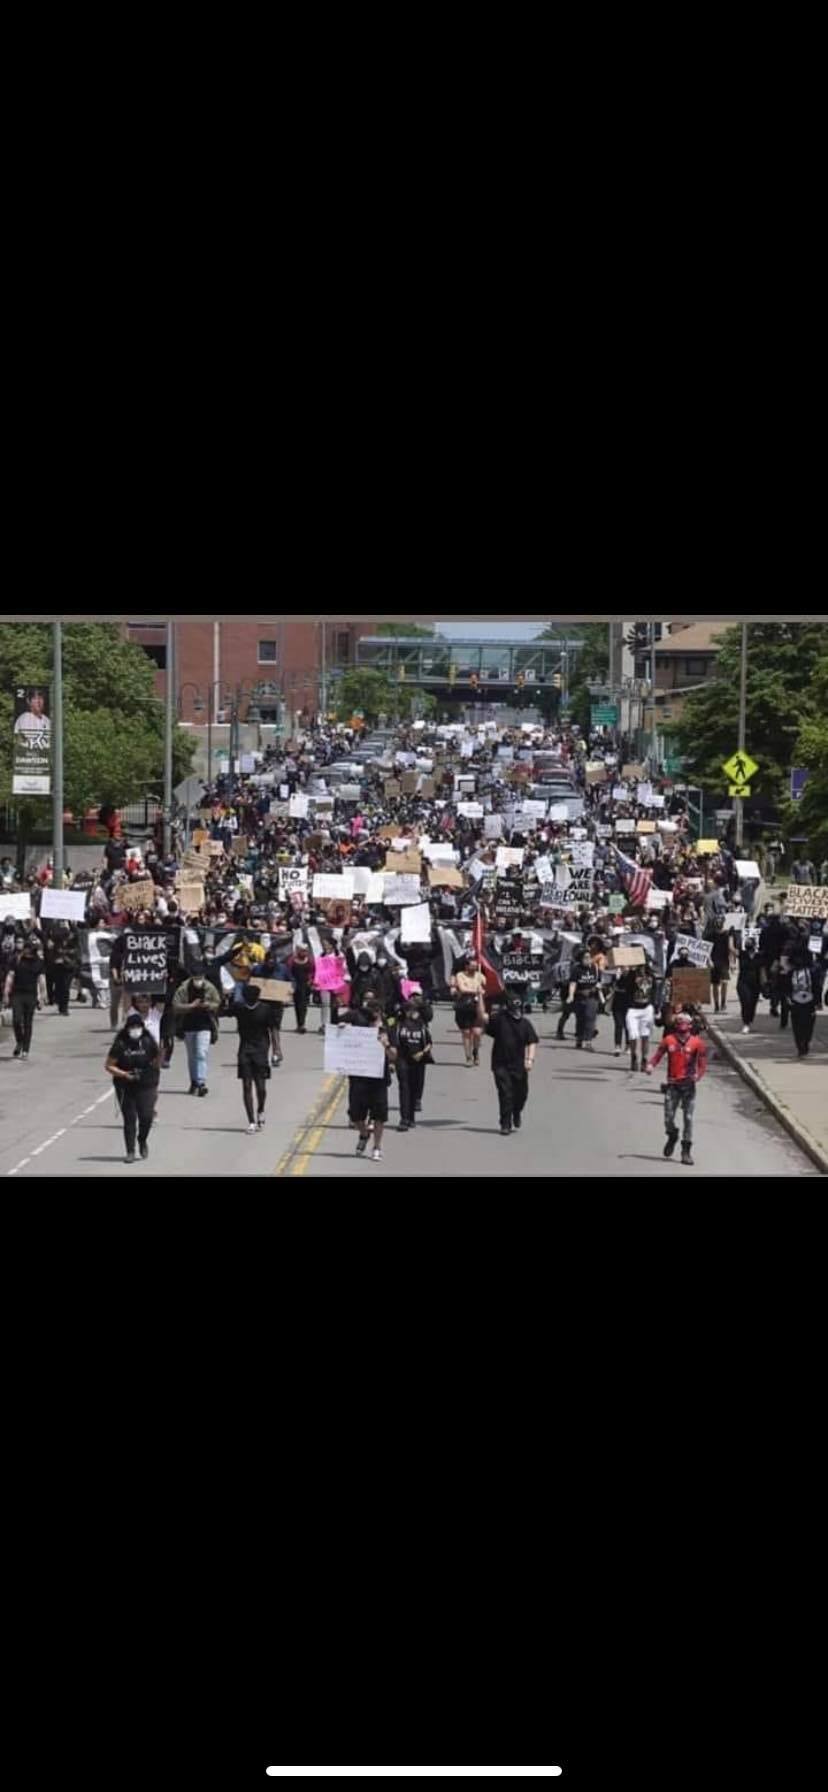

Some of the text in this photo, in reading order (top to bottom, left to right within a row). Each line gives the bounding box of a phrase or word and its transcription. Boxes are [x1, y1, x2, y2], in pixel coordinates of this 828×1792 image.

[17, 688, 25, 698] 2
[282, 870, 300, 880] NO
[568, 867, 593, 879] WE
[568, 881, 590, 890] ARE
